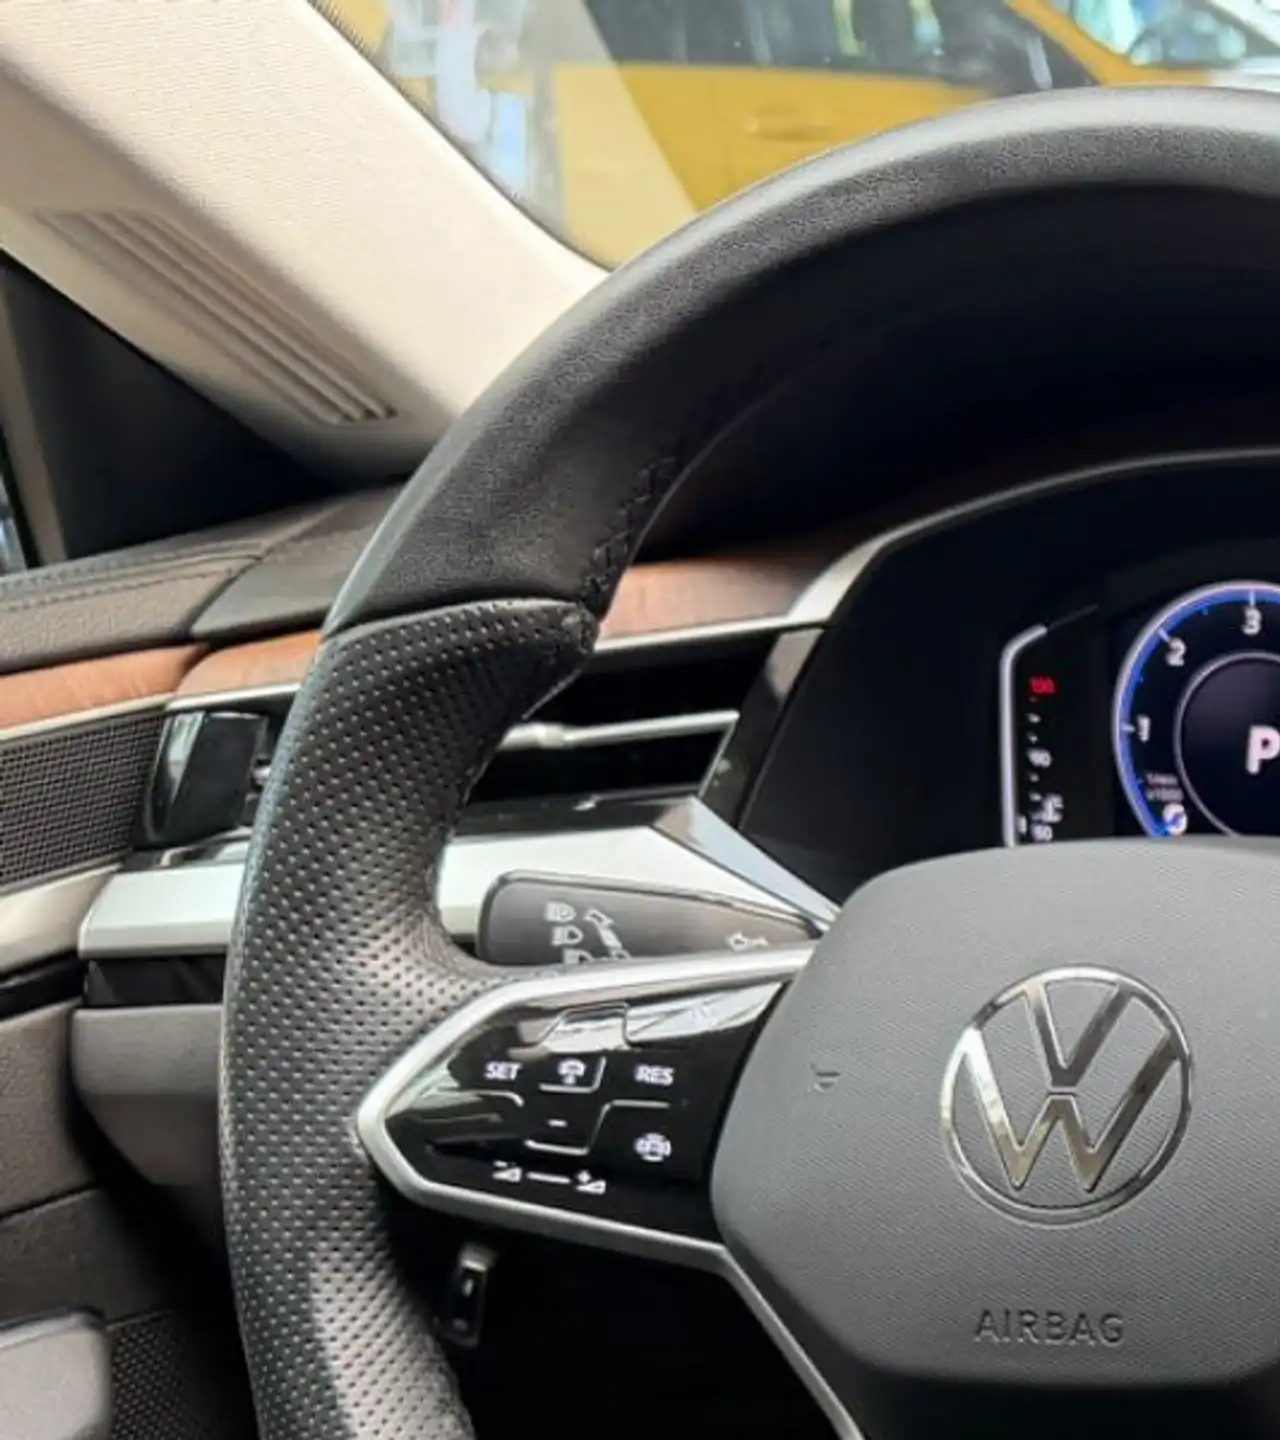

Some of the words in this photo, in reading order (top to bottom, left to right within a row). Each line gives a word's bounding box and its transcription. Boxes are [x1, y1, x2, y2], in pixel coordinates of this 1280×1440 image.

[1242, 607, 1263, 636] 3
[1166, 638, 1187, 667] 2
[1136, 714, 1151, 743] 1
[485, 1062, 521, 1081] SET
[635, 1065, 675, 1085] RES
[974, 1308, 1125, 1348] AIRBAG
